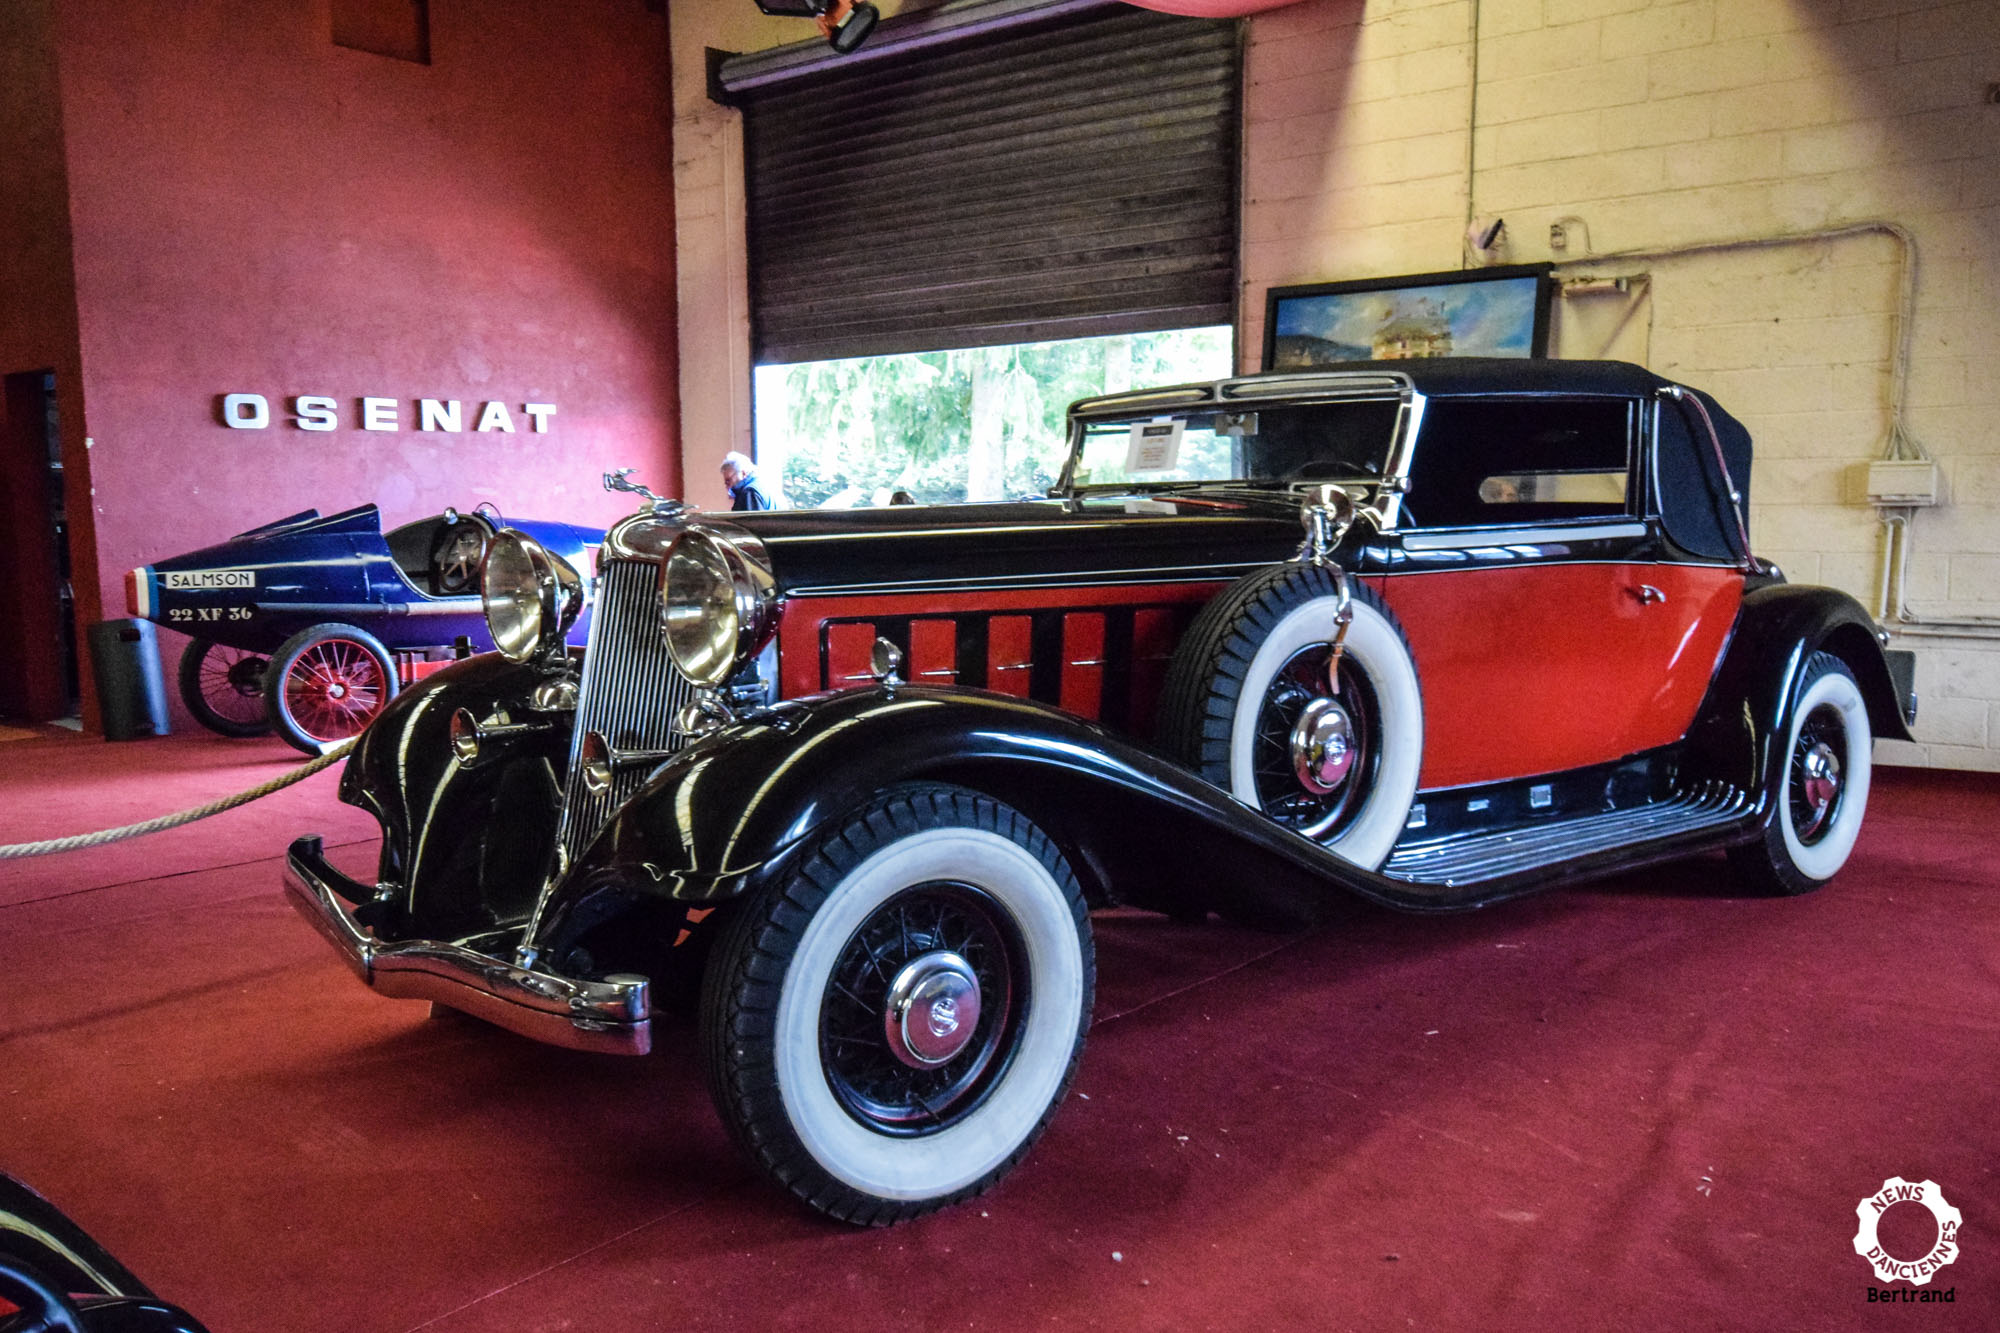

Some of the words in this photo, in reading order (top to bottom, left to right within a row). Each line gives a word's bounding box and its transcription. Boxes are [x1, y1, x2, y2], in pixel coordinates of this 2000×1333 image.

[223, 392, 558, 433] OSENAT
[171, 573, 250, 587] SALMSON
[169, 608, 193, 621] 22
[197, 607, 223, 621] XF
[228, 606, 253, 621] 36
